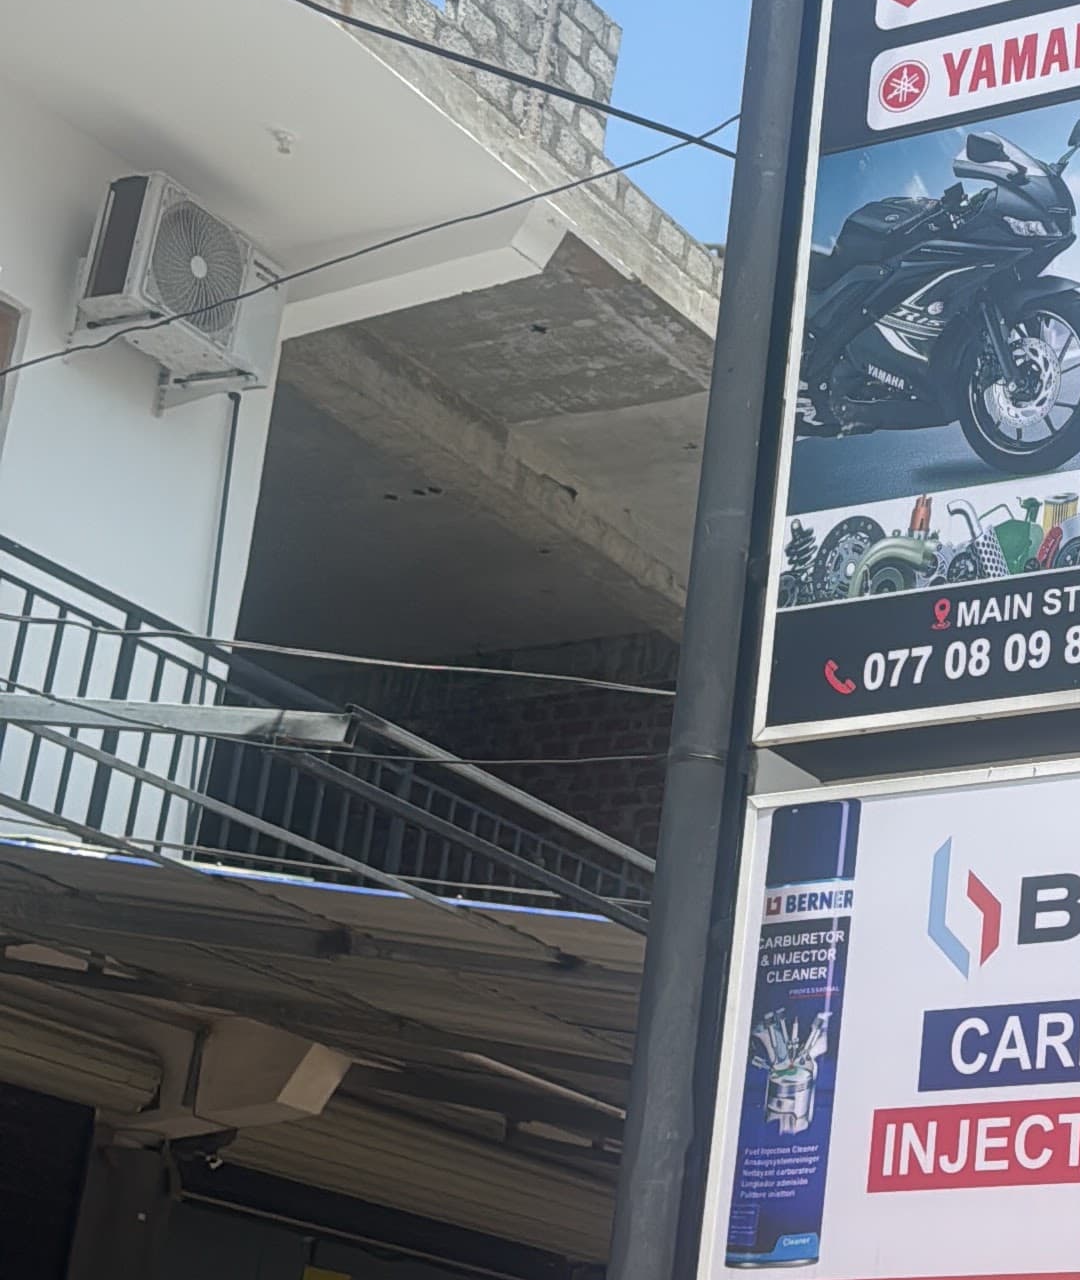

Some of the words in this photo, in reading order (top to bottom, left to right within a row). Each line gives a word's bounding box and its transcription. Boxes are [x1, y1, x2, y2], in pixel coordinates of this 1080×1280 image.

[868, 363, 905, 390] YAMAHA
[955, 592, 1033, 627] MAIN
[862, 645, 934, 693] 077
[944, 637, 992, 680] 08
[1003, 629, 1052, 673] 09
[784, 889, 854, 914] BERNER
[759, 929, 846, 950] CARBURETOR
[760, 954, 770, 967] &
[772, 947, 837, 966] INJECTOR
[766, 966, 828, 984] CLEANER
[792, 1144, 820, 1153] Cleaner
[782, 1237, 811, 1247] Cleaner
